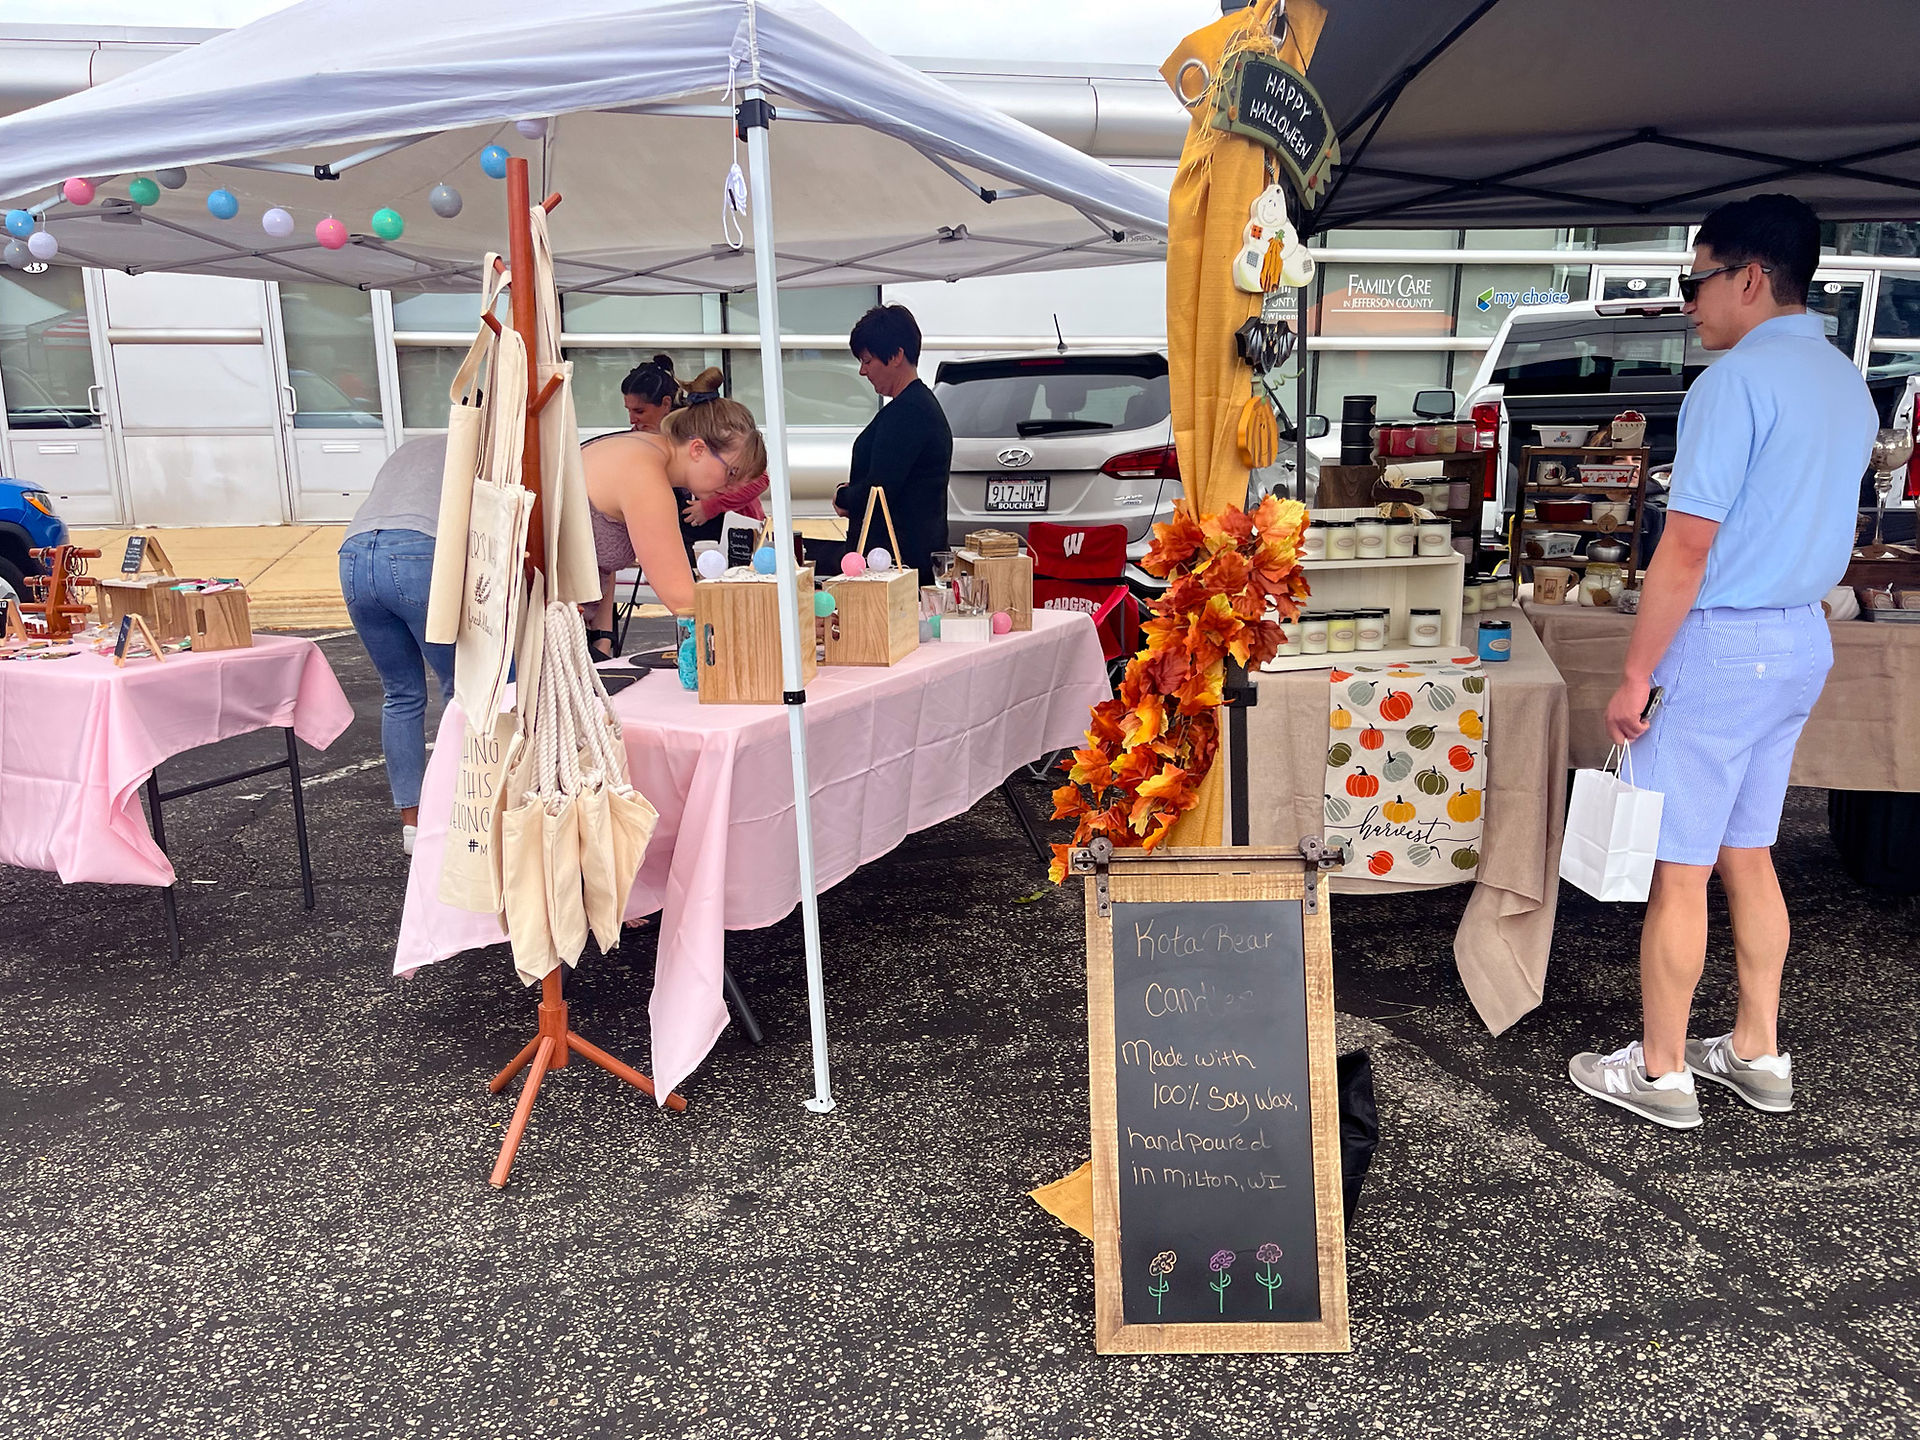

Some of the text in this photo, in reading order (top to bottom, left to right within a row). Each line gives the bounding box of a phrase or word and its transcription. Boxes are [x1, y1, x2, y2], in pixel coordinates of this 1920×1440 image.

[1265, 72, 1312, 122] HAPPY
[1249, 99, 1313, 160] HALLOWEEN
[1348, 274, 1432, 298] FAMILY CARE
[1494, 287, 1570, 308] my choice
[1263, 296, 1297, 308] UNTY
[1351, 298, 1395, 309] JEFFERSON
[1395, 298, 1434, 309] COUNTY
[998, 502, 1034, 510] BOUCHER
[1063, 532, 1085, 558] W
[1044, 596, 1102, 616] BADGERS
[463, 769, 493, 799] THIS
[1344, 805, 1470, 845] harvest
[1134, 918, 1273, 960] Kota Bear
[1121, 1039, 1256, 1075] Made with
[1603, 1068, 1631, 1094] N
[1152, 1082, 1200, 1111] 100%
[1207, 1085, 1251, 1127] Soy
[1130, 1160, 1156, 1185] in
